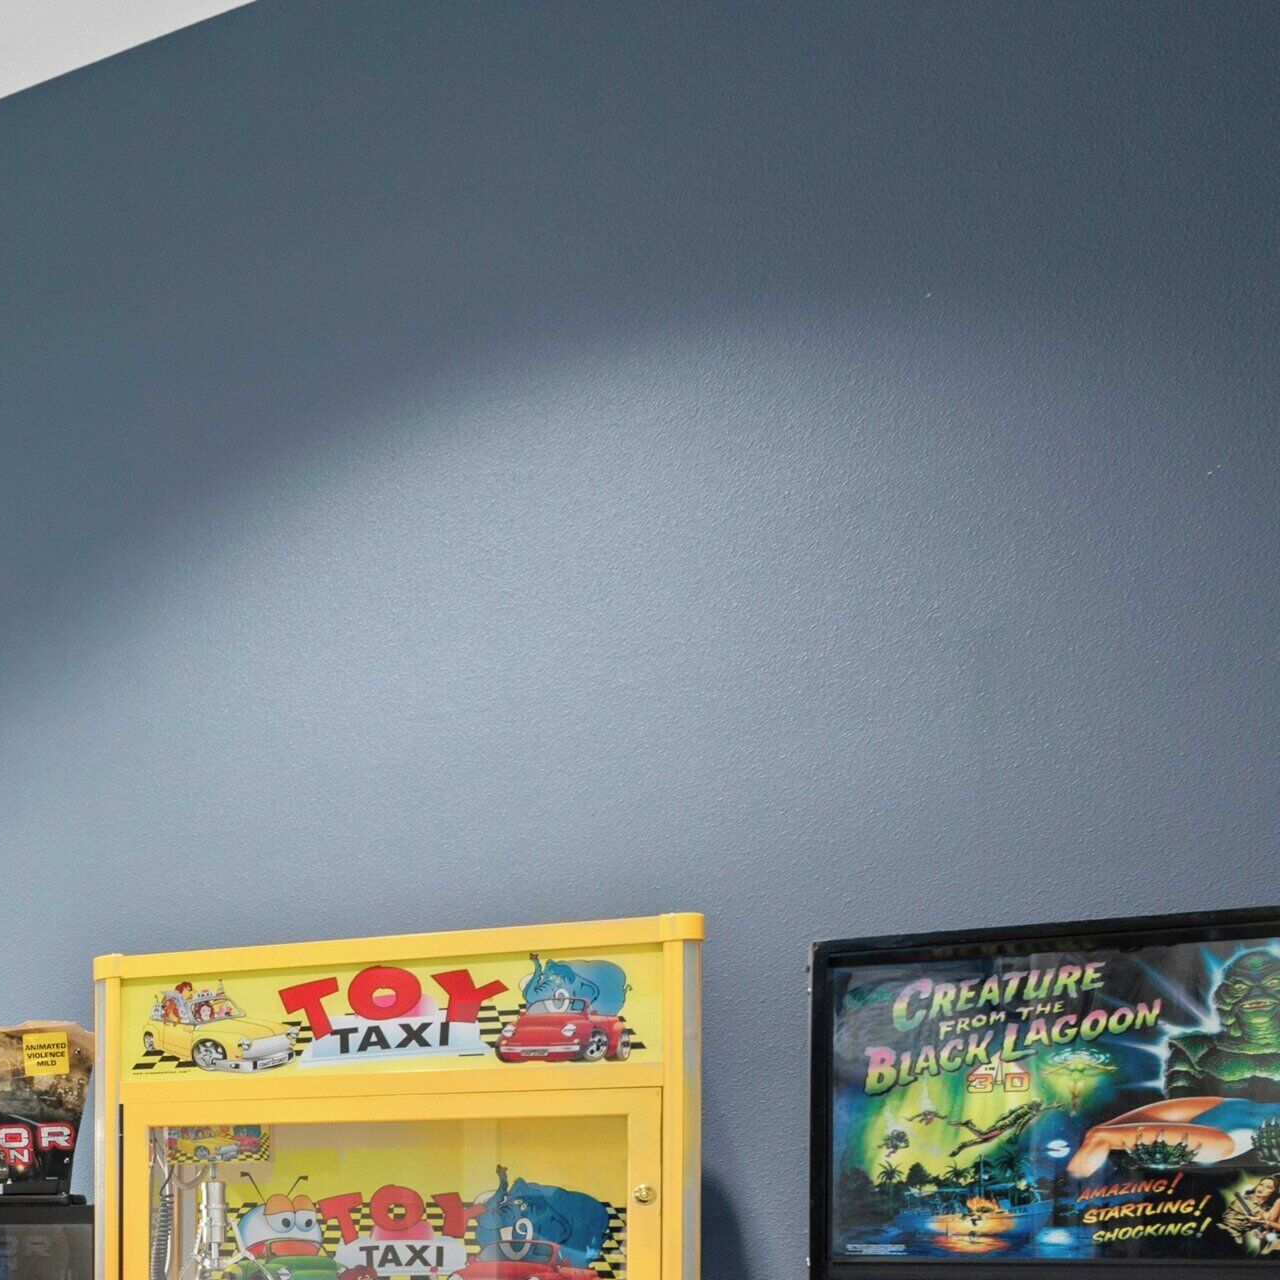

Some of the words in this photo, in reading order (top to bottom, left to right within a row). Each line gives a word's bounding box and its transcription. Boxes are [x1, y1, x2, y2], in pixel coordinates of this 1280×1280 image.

[278, 964, 509, 1040] TOY
[892, 961, 1106, 1034] CREATURE
[939, 1012, 1012, 1040] FROM
[1016, 1000, 1065, 1023] THE
[25, 1042, 67, 1051] ANIMATED
[331, 1021, 450, 1054] TAXI
[864, 1028, 994, 1096] BLACK
[1002, 998, 1162, 1061] LAGOON
[27, 1051, 65, 1059] VIOLENCE
[966, 1072, 1031, 1094] 3-D
[1077, 1173, 1183, 1203] AMAZING!
[318, 1183, 487, 1244] TOY
[1082, 1194, 1208, 1226] STARTLING!
[1091, 1216, 1213, 1245] SHOCKING!
[359, 1245, 445, 1267] TAXI
